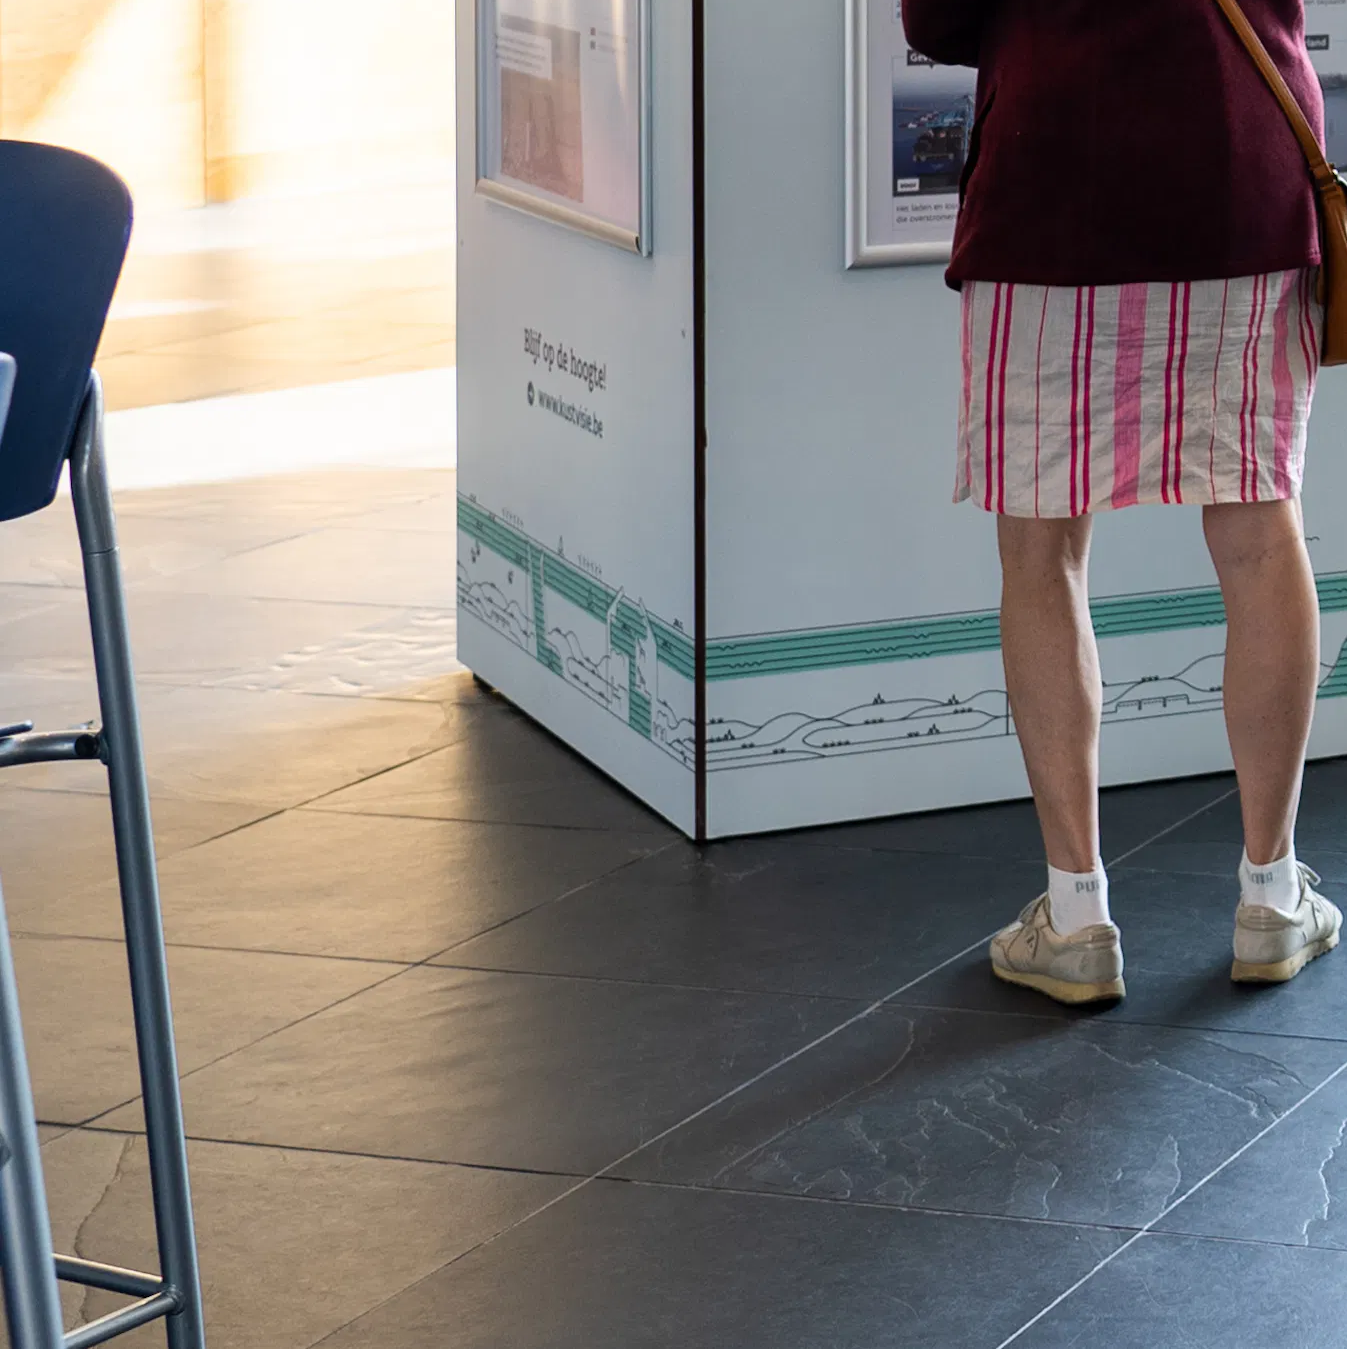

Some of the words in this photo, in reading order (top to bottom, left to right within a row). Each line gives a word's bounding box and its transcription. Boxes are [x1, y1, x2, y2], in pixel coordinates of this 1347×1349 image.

[1306, 37, 1327, 48] land
[524, 328, 542, 365] Blijf
[543, 342, 554, 372] op
[557, 343, 568, 372] de
[570, 347, 606, 393] hoogte!
[538, 388, 604, 439] www.kustvisie.be
[1075, 879, 1101, 893] PU
